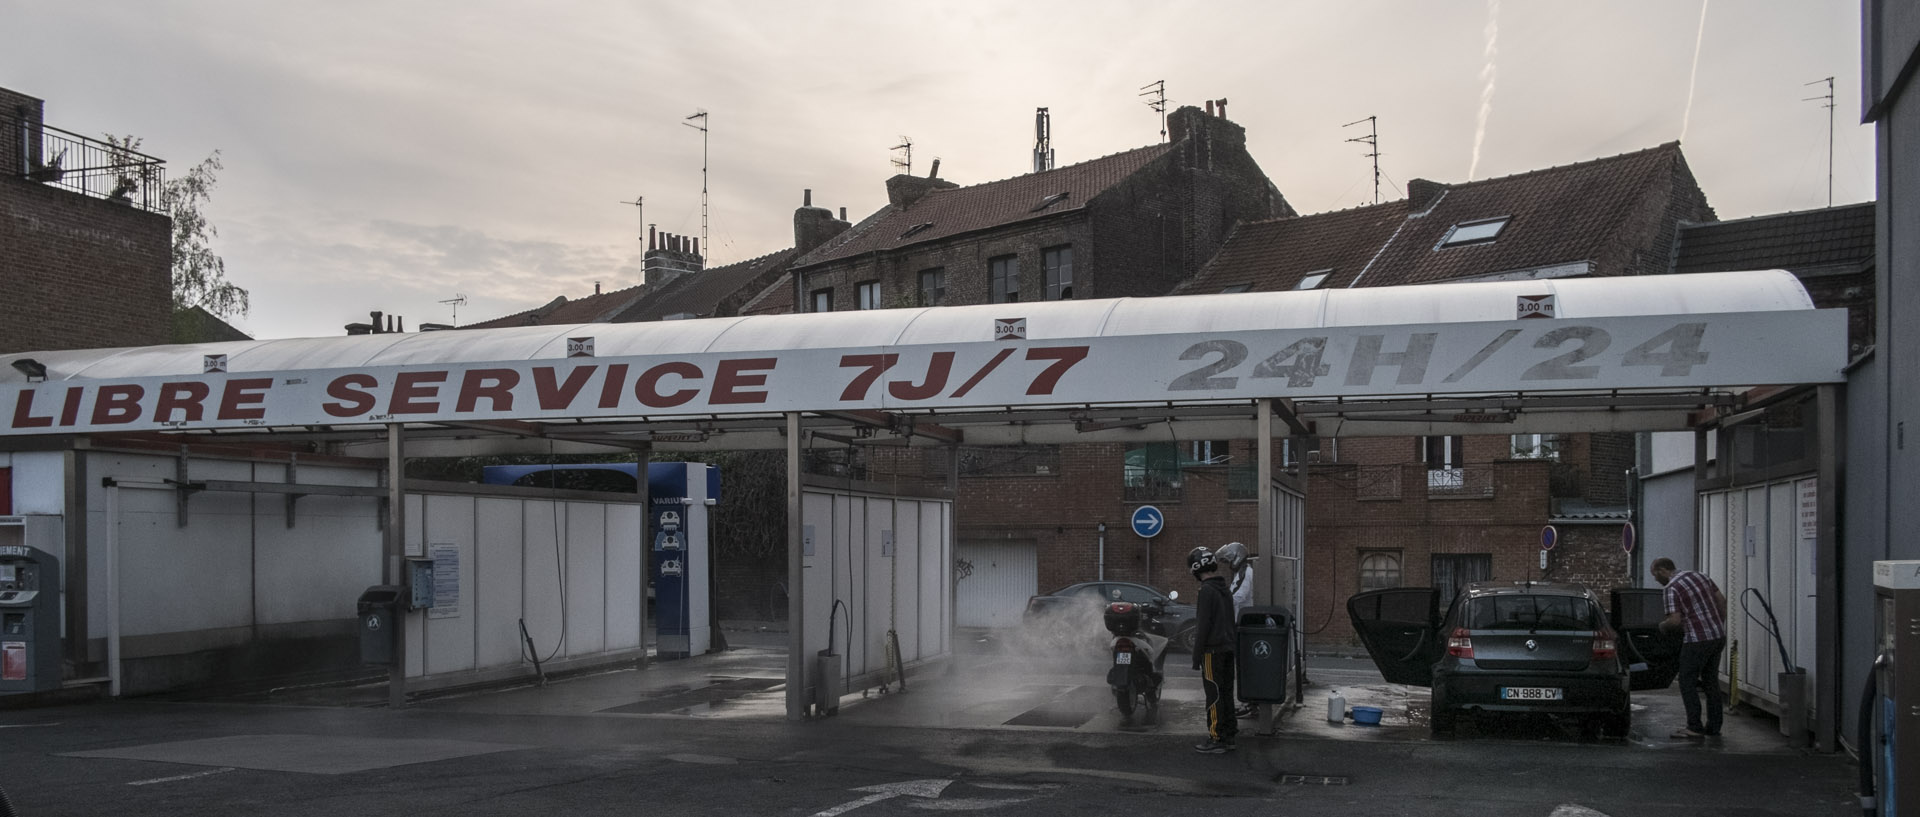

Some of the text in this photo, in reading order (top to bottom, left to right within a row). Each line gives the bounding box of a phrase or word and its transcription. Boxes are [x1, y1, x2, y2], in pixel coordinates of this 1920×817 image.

[1518, 302, 1540, 312] 3.00
[996, 325, 1014, 334] 3.00
[568, 343, 584, 352] 3.00
[11, 322, 1710, 428] LIBRE SERVICE 7J/7 24H/24
